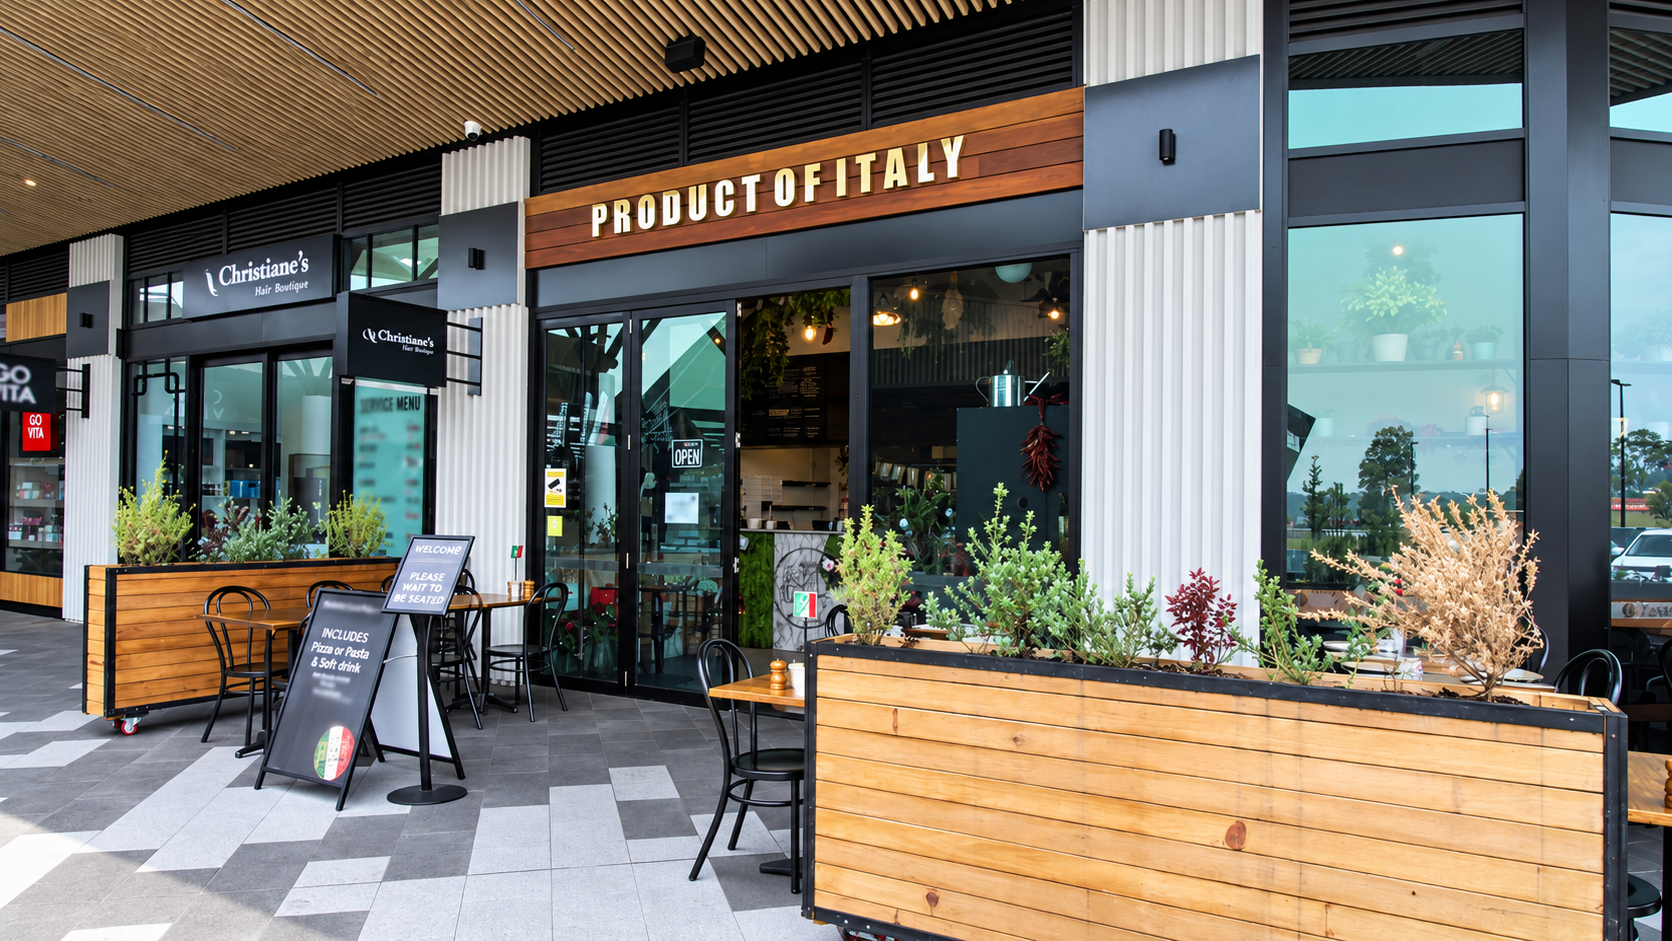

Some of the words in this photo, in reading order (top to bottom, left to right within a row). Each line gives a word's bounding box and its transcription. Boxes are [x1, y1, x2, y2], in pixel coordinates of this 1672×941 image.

[591, 173, 761, 238] PRODUCT
[774, 162, 821, 207] OF
[836, 134, 964, 197] ITALY
[219, 250, 309, 286] Christiane's
[255, 286, 272, 296] Hair
[275, 281, 309, 293] Boutique
[378, 329, 434, 348] Christiane's
[0, 384, 37, 404] ITA
[397, 395, 421, 412] MENU
[29, 414, 42, 426] GO
[27, 427, 45, 439] VITA
[674, 448, 700, 466] OPEN
[409, 571, 445, 582] PLEASE
[402, 582, 427, 592] WAIT
[429, 583, 443, 593] TO
[393, 593, 407, 603] BE
[407, 595, 445, 605] SEATED
[321, 627, 369, 644] INCLUDES
[310, 641, 334, 655] Pizza
[334, 647, 345, 656] or
[345, 646, 370, 660] Pasta
[318, 657, 338, 670] Soft
[337, 661, 361, 674] drink
